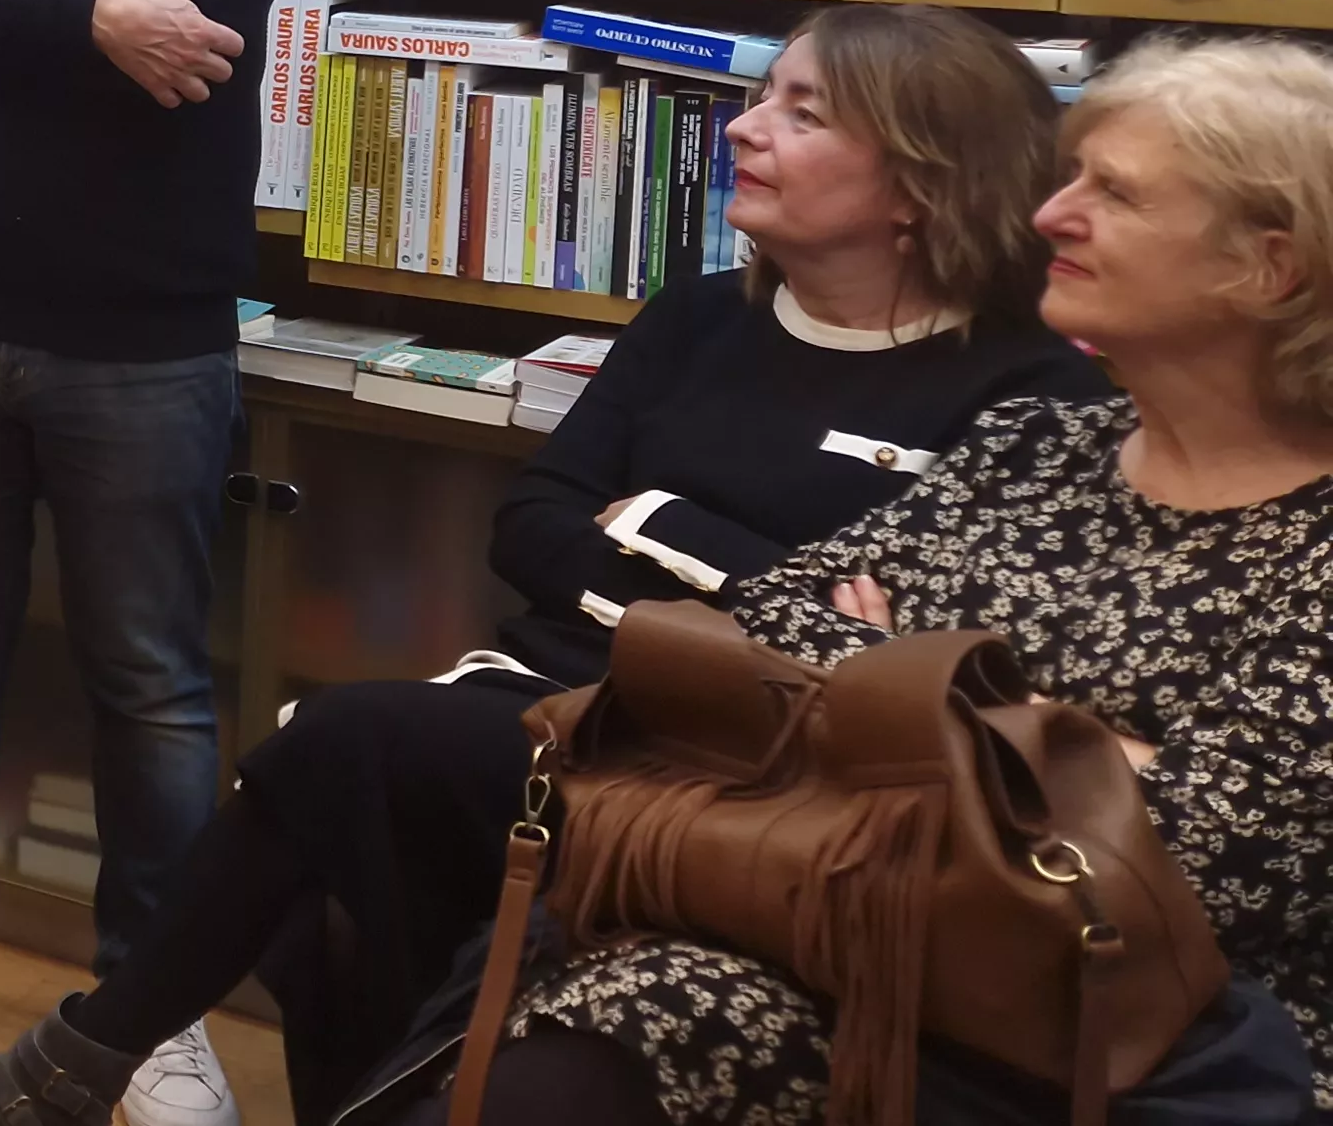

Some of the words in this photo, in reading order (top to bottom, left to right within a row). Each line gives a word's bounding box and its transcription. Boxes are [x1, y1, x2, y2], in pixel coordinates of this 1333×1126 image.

[276, 6, 295, 60] SAURA
[301, 9, 321, 62] SAURA
[339, 33, 398, 53] SAURA
[400, 37, 470, 58] CARLOS
[594, 27, 650, 47] CUERPO
[651, 35, 715, 59] NUESTRO
[270, 62, 290, 124] CARLOS
[296, 65, 316, 127] CARLOS
[390, 69, 405, 99] ALBERT
[387, 101, 404, 138] ESPINOSA
[566, 93, 578, 131] ILUMINA
[422, 128, 431, 176] EMOCIONAL
[565, 133, 576, 148] TUS
[602, 110, 615, 161] Altamente
[312, 163, 320, 187] ROJAS
[326, 164, 334, 187] ROJAS
[338, 166, 346, 189] ROJAS
[563, 150, 574, 192] SOMBRAS
[600, 163, 612, 202] sensible
[310, 189, 320, 222] ENRIQUE
[323, 189, 333, 223] ENRIQUE
[336, 191, 346, 226] ENRIQUE
[348, 186, 363, 224] ESPINOSA
[365, 188, 381, 226] ESPINOSA
[419, 178, 427, 219] HERENCIA
[510, 168, 524, 223] DIGNIDAD
[346, 225, 360, 254] ALBERT
[363, 227, 378, 256] ALBERT
